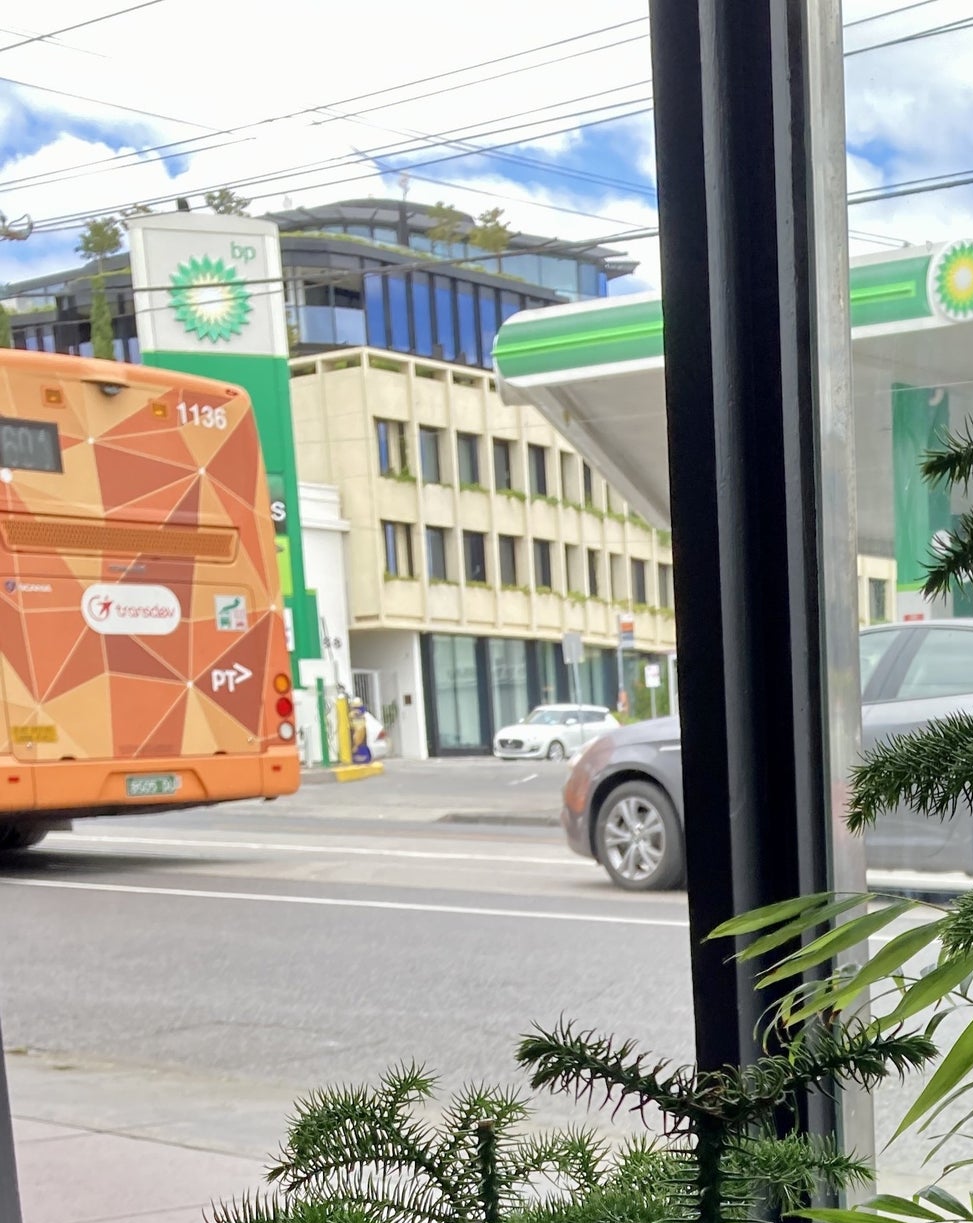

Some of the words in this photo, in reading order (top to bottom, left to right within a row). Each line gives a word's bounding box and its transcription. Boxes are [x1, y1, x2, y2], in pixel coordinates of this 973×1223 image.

[230, 240, 257, 265] bp
[176, 401, 228, 430] 1136
[115, 603, 176, 619] transdev
